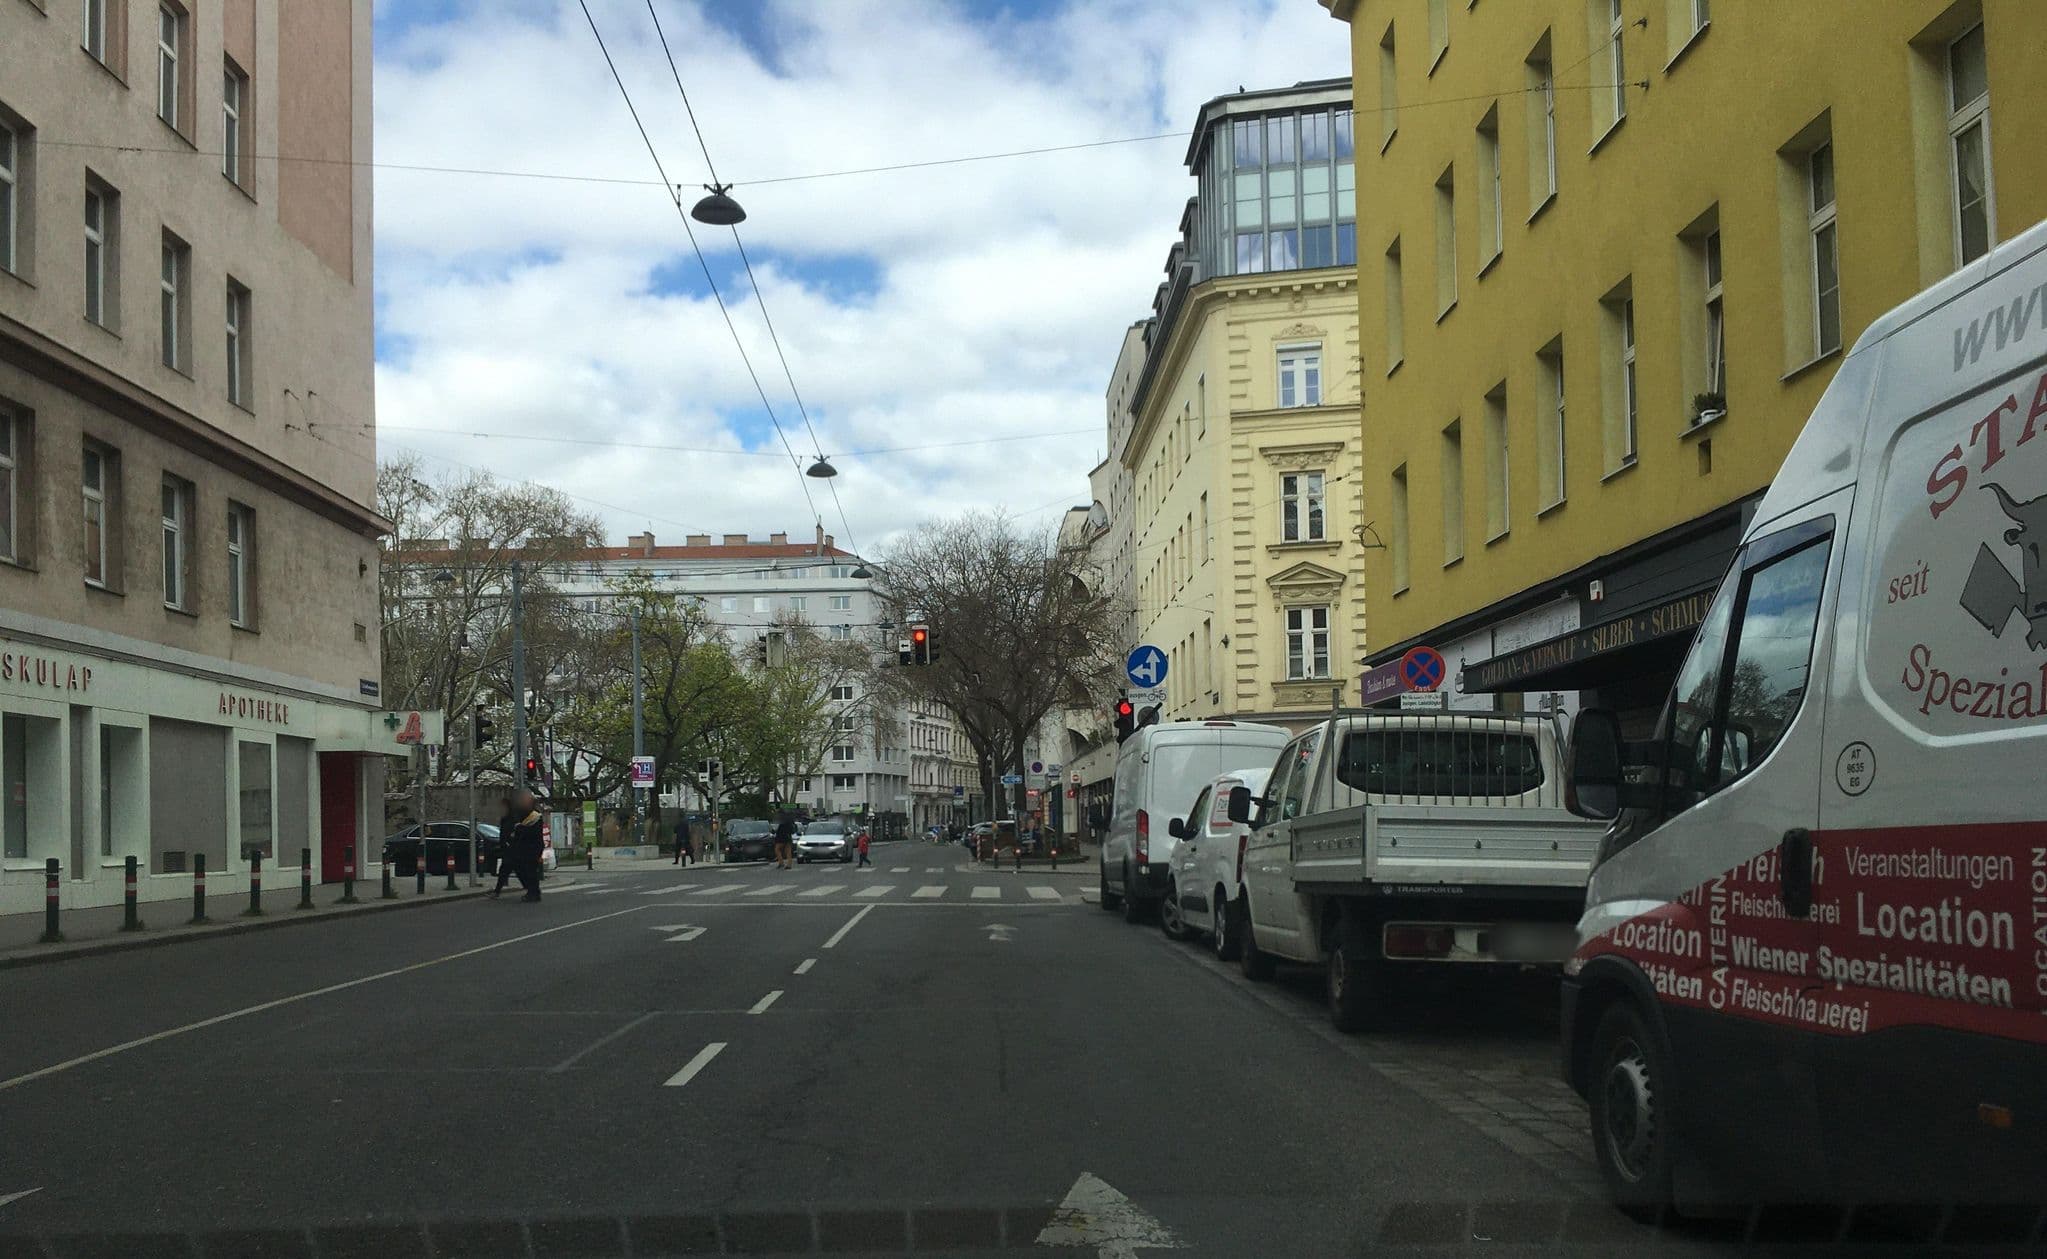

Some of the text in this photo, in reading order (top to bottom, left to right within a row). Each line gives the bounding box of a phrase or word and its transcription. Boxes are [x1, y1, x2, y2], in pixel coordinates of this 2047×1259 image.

[1888, 560, 1931, 604] seit
[1592, 618, 1635, 653] SILBER
[219, 692, 289, 726] APOTHEKE
[1851, 748, 1861, 760] AT
[1845, 846, 2015, 890] Veranstaltungen
[1397, 886, 1463, 894] TRANSPORTER
[1612, 918, 1702, 959] Location
[1857, 891, 2016, 951] Location
[1731, 935, 2014, 1009] Wiener Spezialitäten
[1731, 977, 1870, 1033] Fleischhauerei
